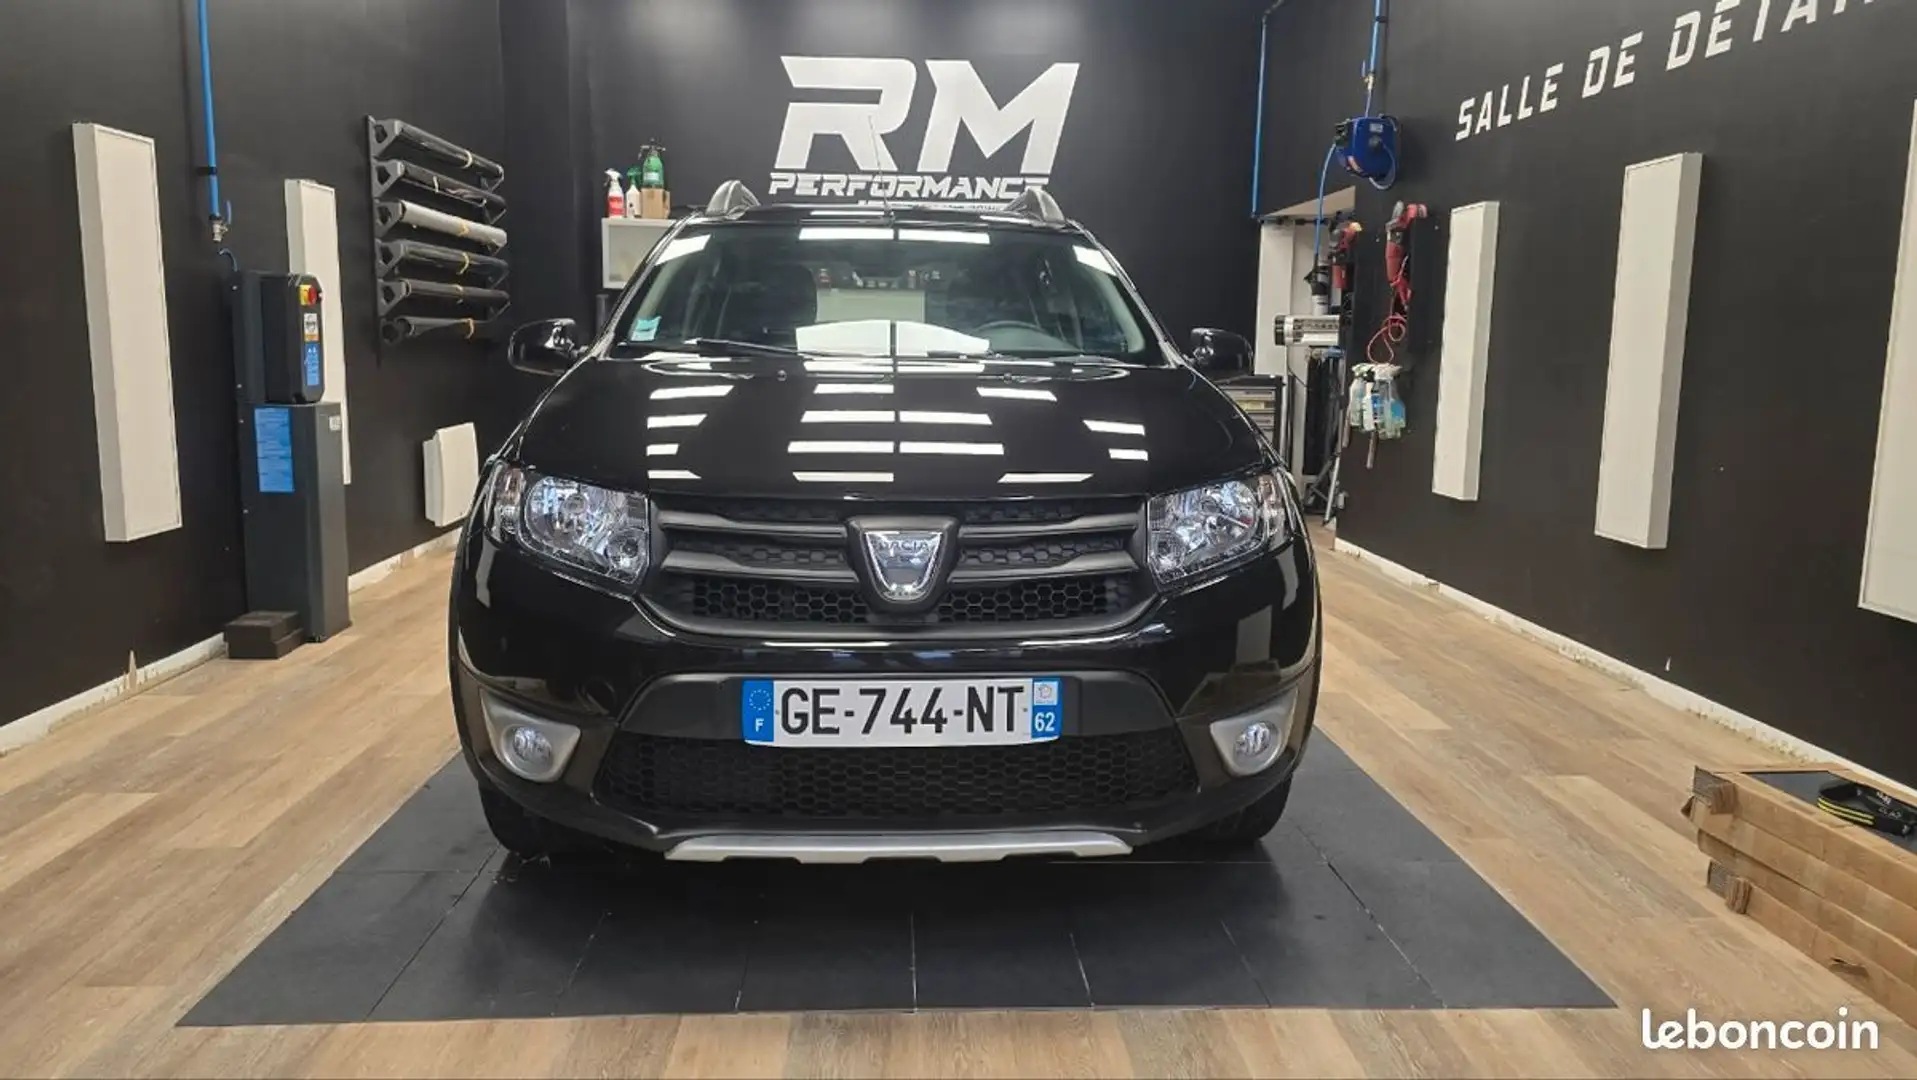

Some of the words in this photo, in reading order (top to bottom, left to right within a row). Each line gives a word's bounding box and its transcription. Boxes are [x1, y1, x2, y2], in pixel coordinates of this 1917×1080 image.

[1455, 62, 1564, 141] SALLE
[1582, 32, 1643, 98] DE
[774, 55, 1080, 174] RM
[755, 718, 764, 732] F
[781, 686, 1024, 735] GE-744-NT
[1035, 712, 1055, 732] 62
